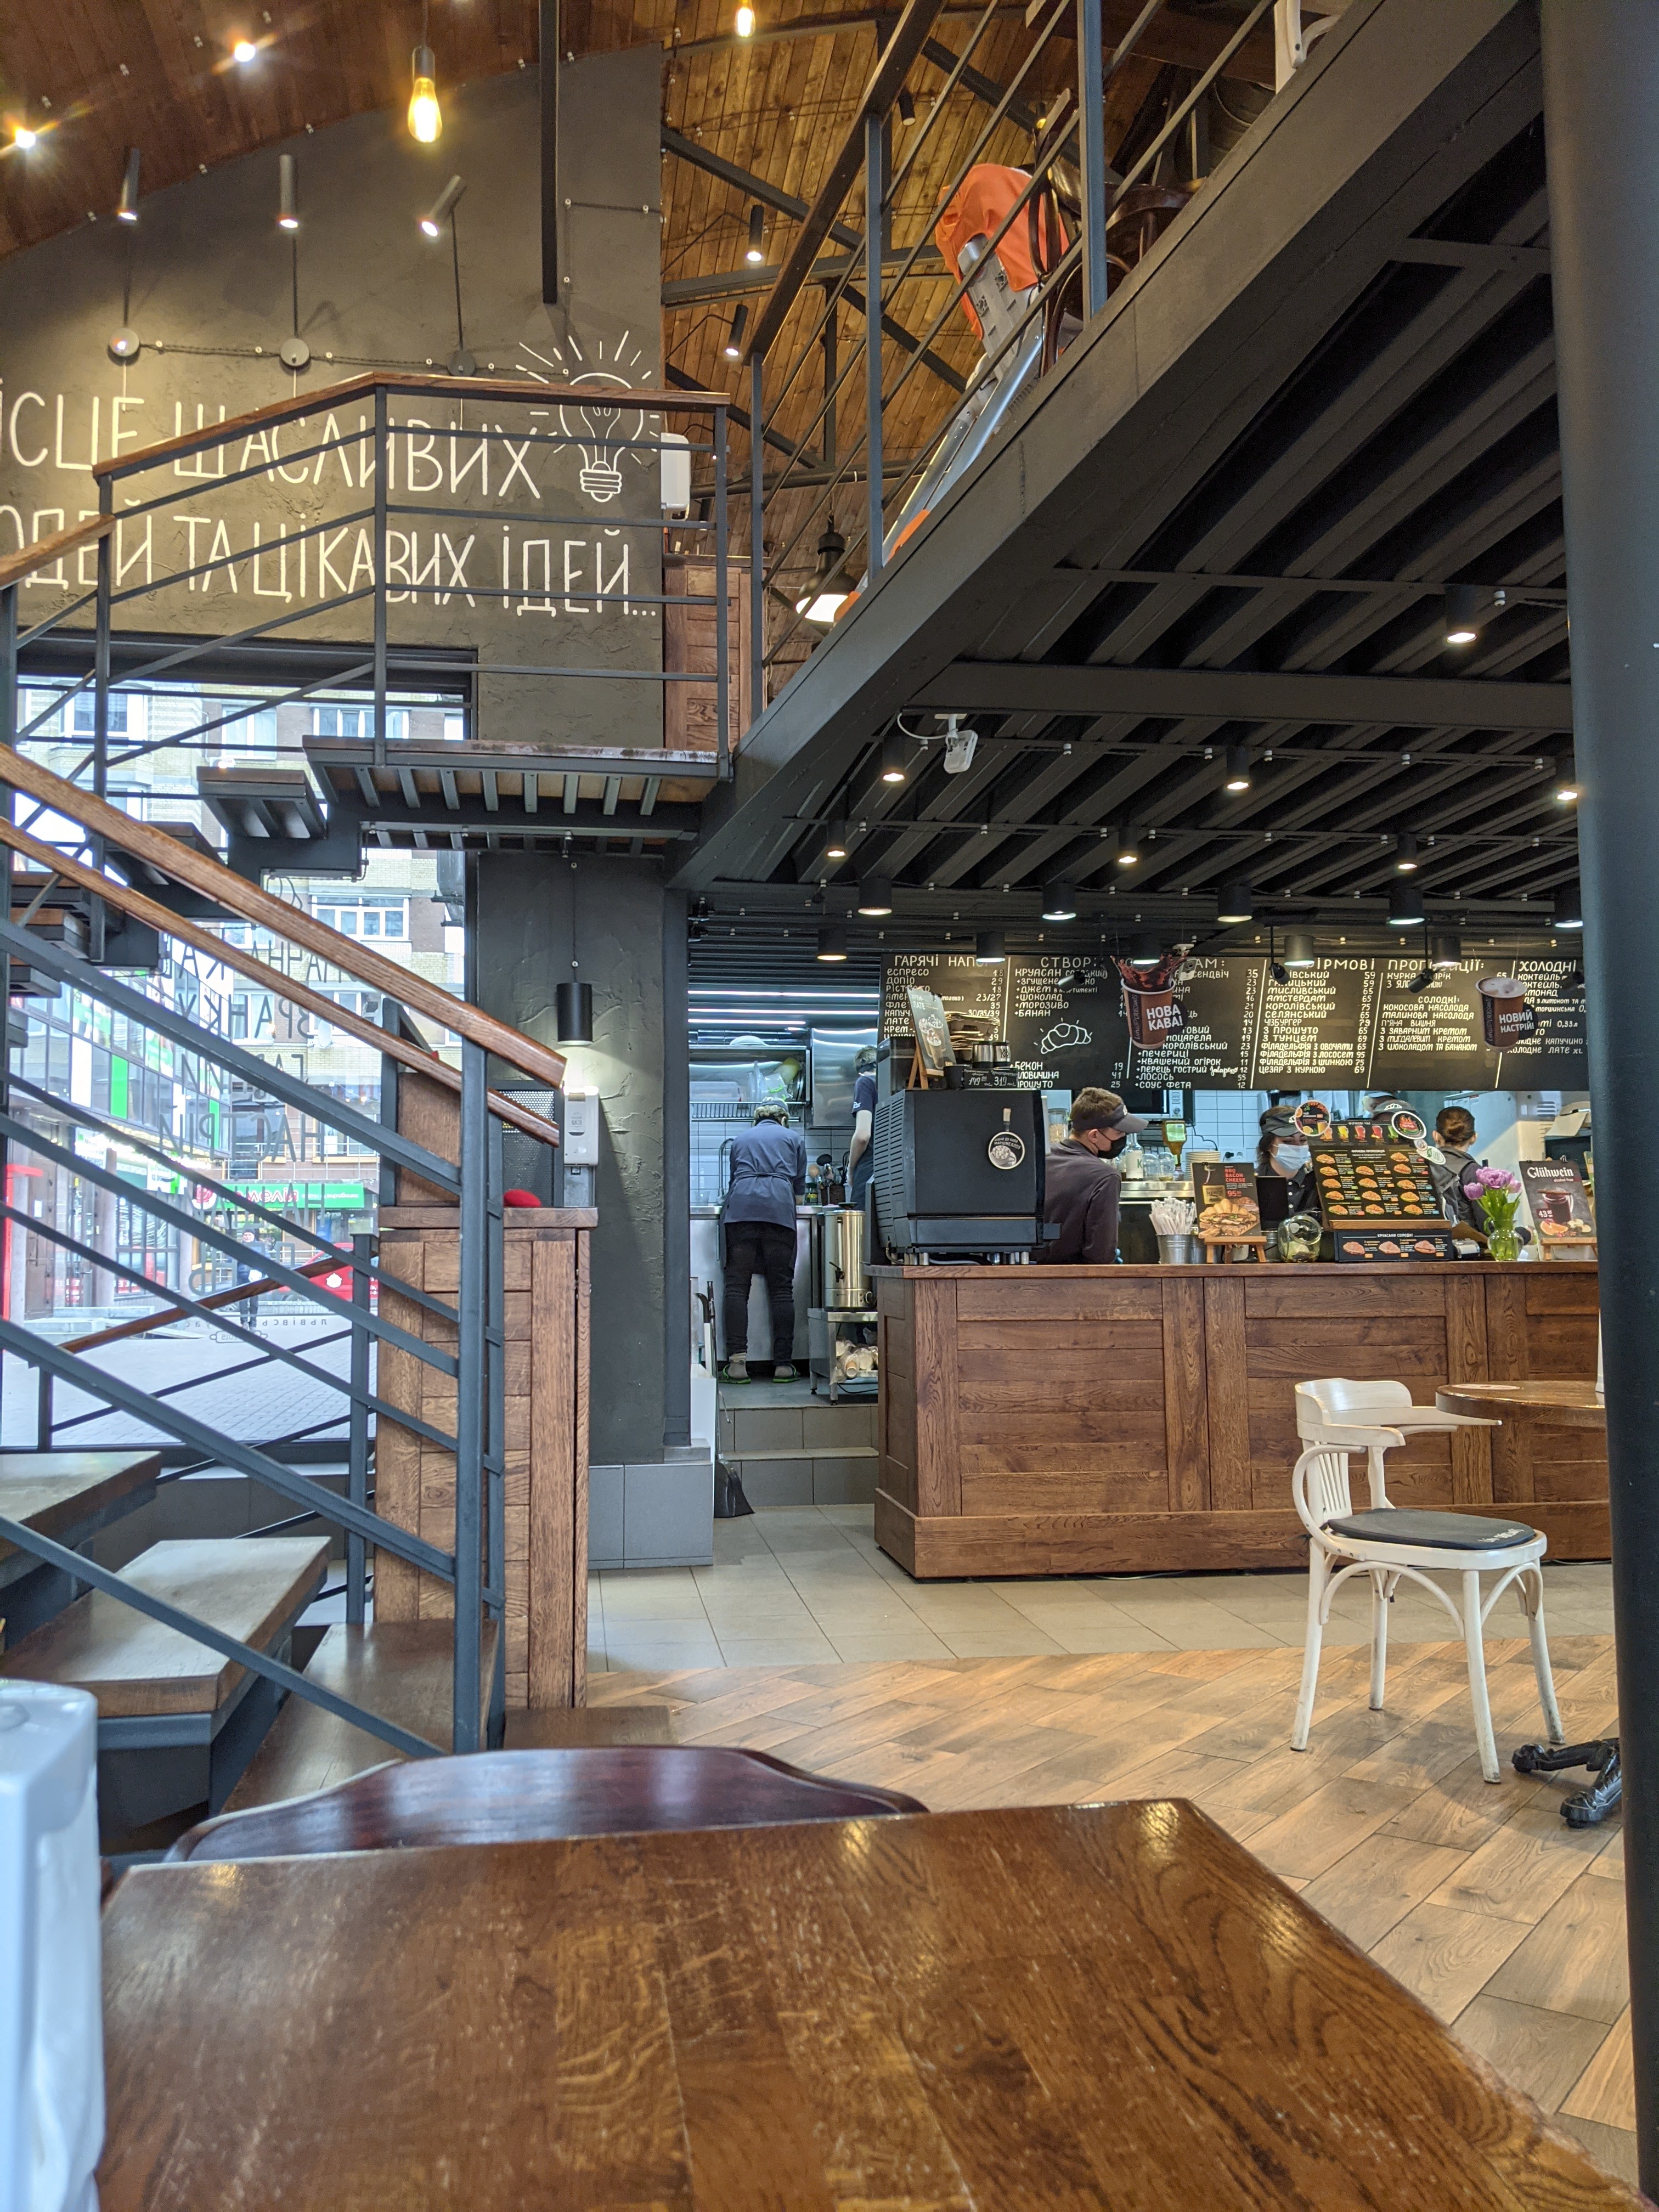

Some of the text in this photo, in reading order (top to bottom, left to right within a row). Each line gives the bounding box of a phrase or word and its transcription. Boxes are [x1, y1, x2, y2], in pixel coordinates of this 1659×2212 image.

[173, 515, 238, 593] ТА
[253, 513, 475, 607] ЦІКАВИХ
[894, 954, 939, 967] ГАРЯЧІ
[1519, 960, 1576, 974] ХОЛОДНІ
[1015, 968, 1061, 977] КРУАСАН
[1247, 969, 1258, 978] 35
[1517, 973, 1560, 981] КОКТЕЙЛЬ
[1268, 986, 1336, 995] МИСЛИВСЬКИЙ
[1267, 995, 1325, 1003] АМСТЕРДАМ
[1266, 1002, 1335, 1010] КОРОЛІВСЬКИЙ
[1147, 1004, 1181, 1019] НОВА
[1265, 1010, 1327, 1018] СЕЛЯНСЬКИЙ
[1433, 1012, 1474, 1020] НАСОЛОДА
[1499, 1009, 1533, 1024] НОВИЙ
[1148, 1015, 1183, 1031] КАВА!
[1273, 1026, 1318, 1035] ПРОШУТО
[1273, 1035, 1317, 1043] ТУНЦЕМ
[1163, 1042, 1228, 1050] КОРОЛІВСЬКИЙ
[1261, 1042, 1311, 1051] ФІЛАДЕЛЬФІЯ
[1387, 1043, 1433, 1052] ШОКОЛАДОМ
[1260, 1050, 1311, 1058] ФІЛАДЕЛЬФІЯ
[1194, 1057, 1221, 1065] ОГІРОК
[1260, 1058, 1310, 1066] ФІЛАДЕЛЬФІЯ
[1114, 1063, 1123, 1071] 19
[1173, 1065, 1206, 1074] ГОСТРИЙ
[1259, 1066, 1283, 1075] ЦЕЗАР
[994, 1076, 1007, 1086] 319
[1527, 1166, 1574, 1178] Glühwein
